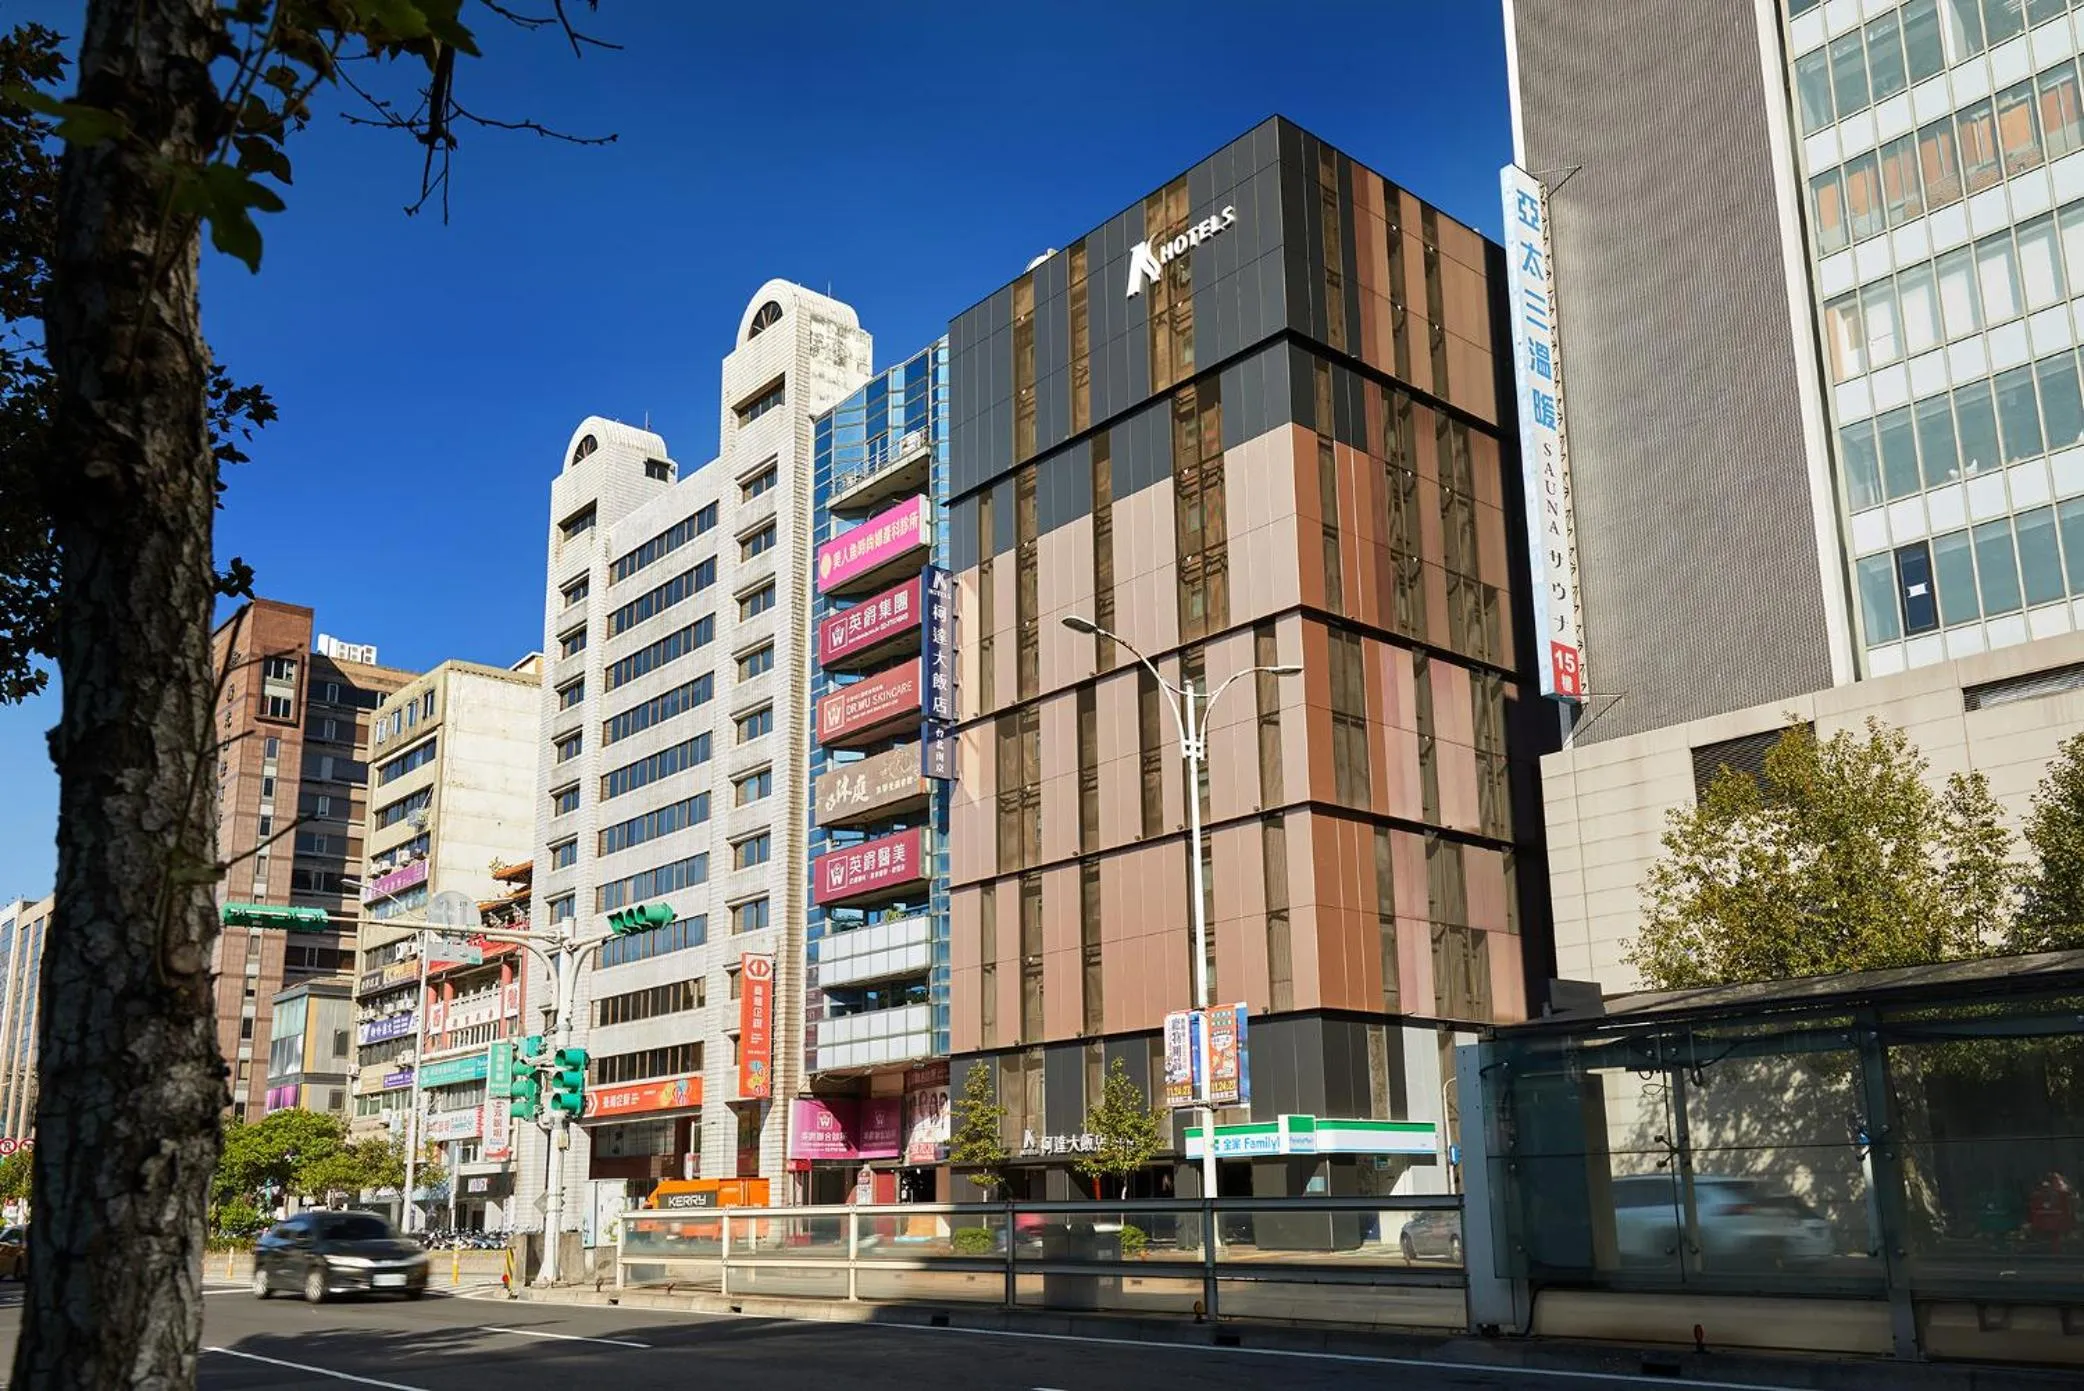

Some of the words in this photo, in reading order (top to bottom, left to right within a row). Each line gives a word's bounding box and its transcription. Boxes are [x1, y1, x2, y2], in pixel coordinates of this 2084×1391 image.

[1160, 205, 1236, 265] HOTELS
[1516, 188, 1557, 431] 亞太三溫暖
[1543, 442, 1560, 536] SAUNA
[1550, 549, 1569, 632] サウナ
[932, 603, 948, 715] 柯達大飯店
[1555, 650, 1576, 674] 15
[872, 680, 913, 705] SKINCARE
[1223, 1137, 1241, 1151] 全家
[668, 1194, 707, 1207] KERRY
